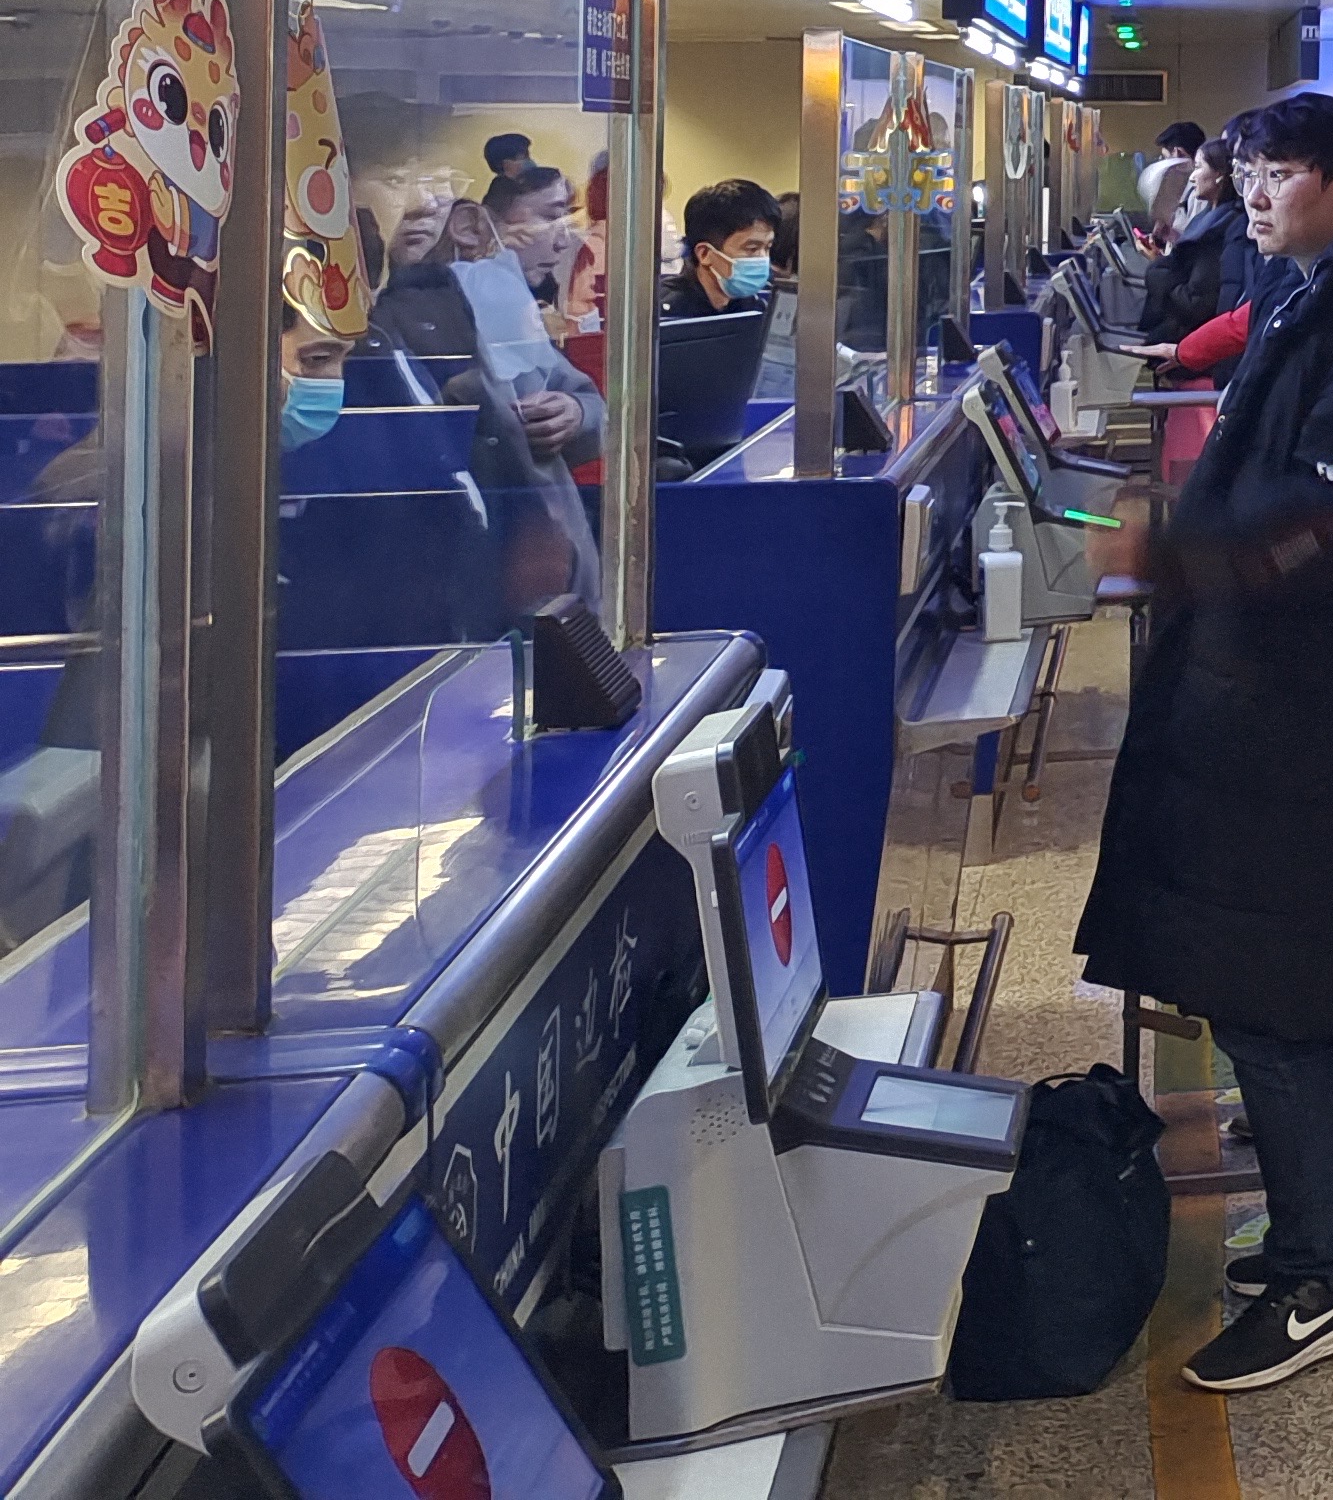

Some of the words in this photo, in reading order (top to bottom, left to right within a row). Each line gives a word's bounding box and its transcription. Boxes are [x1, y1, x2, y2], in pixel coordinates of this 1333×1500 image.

[93, 182, 135, 236] 吉
[494, 905, 638, 1225] 中国边检
